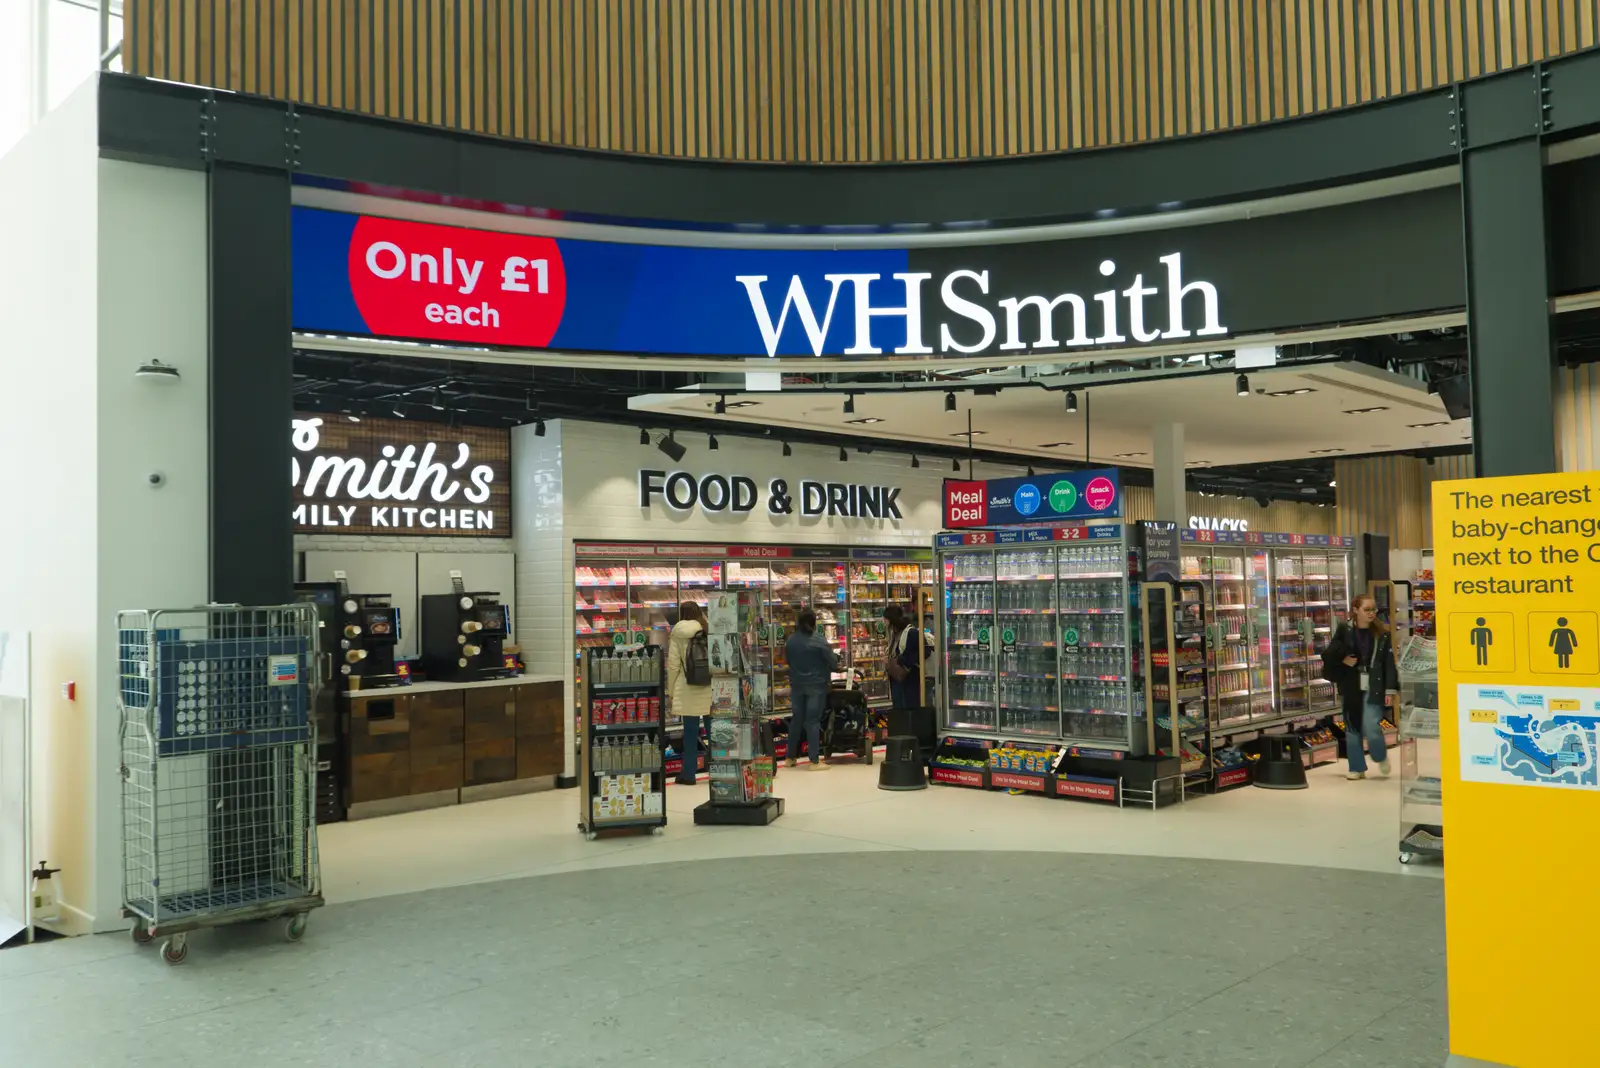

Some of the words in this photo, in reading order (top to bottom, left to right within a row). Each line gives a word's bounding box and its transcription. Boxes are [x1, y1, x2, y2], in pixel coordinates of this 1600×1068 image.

[366, 241, 484, 294] Only
[501, 256, 549, 294] £1
[425, 301, 500, 328] each
[735, 251, 1228, 358] WHSmith
[639, 469, 758, 512] FOOD
[767, 478, 794, 514] &
[801, 481, 903, 519] DRINK
[950, 489, 983, 505] Meal
[1054, 488, 1071, 496] Drink
[1090, 486, 1110, 494] Snack
[1450, 491, 1494, 510] The
[1501, 485, 1592, 507] nearest
[371, 506, 494, 529] KITCHEN
[951, 507, 983, 521] Deal
[1188, 515, 1249, 531] SNACKS
[1452, 516, 1600, 541] baby-chang
[743, 547, 760, 556] Meal
[761, 547, 777, 556] Deal
[1453, 548, 1502, 566] next
[1508, 547, 1532, 565] to
[1539, 545, 1579, 564] the
[1453, 575, 1574, 594] restaurant
[1085, 786, 1097, 794] Meal
